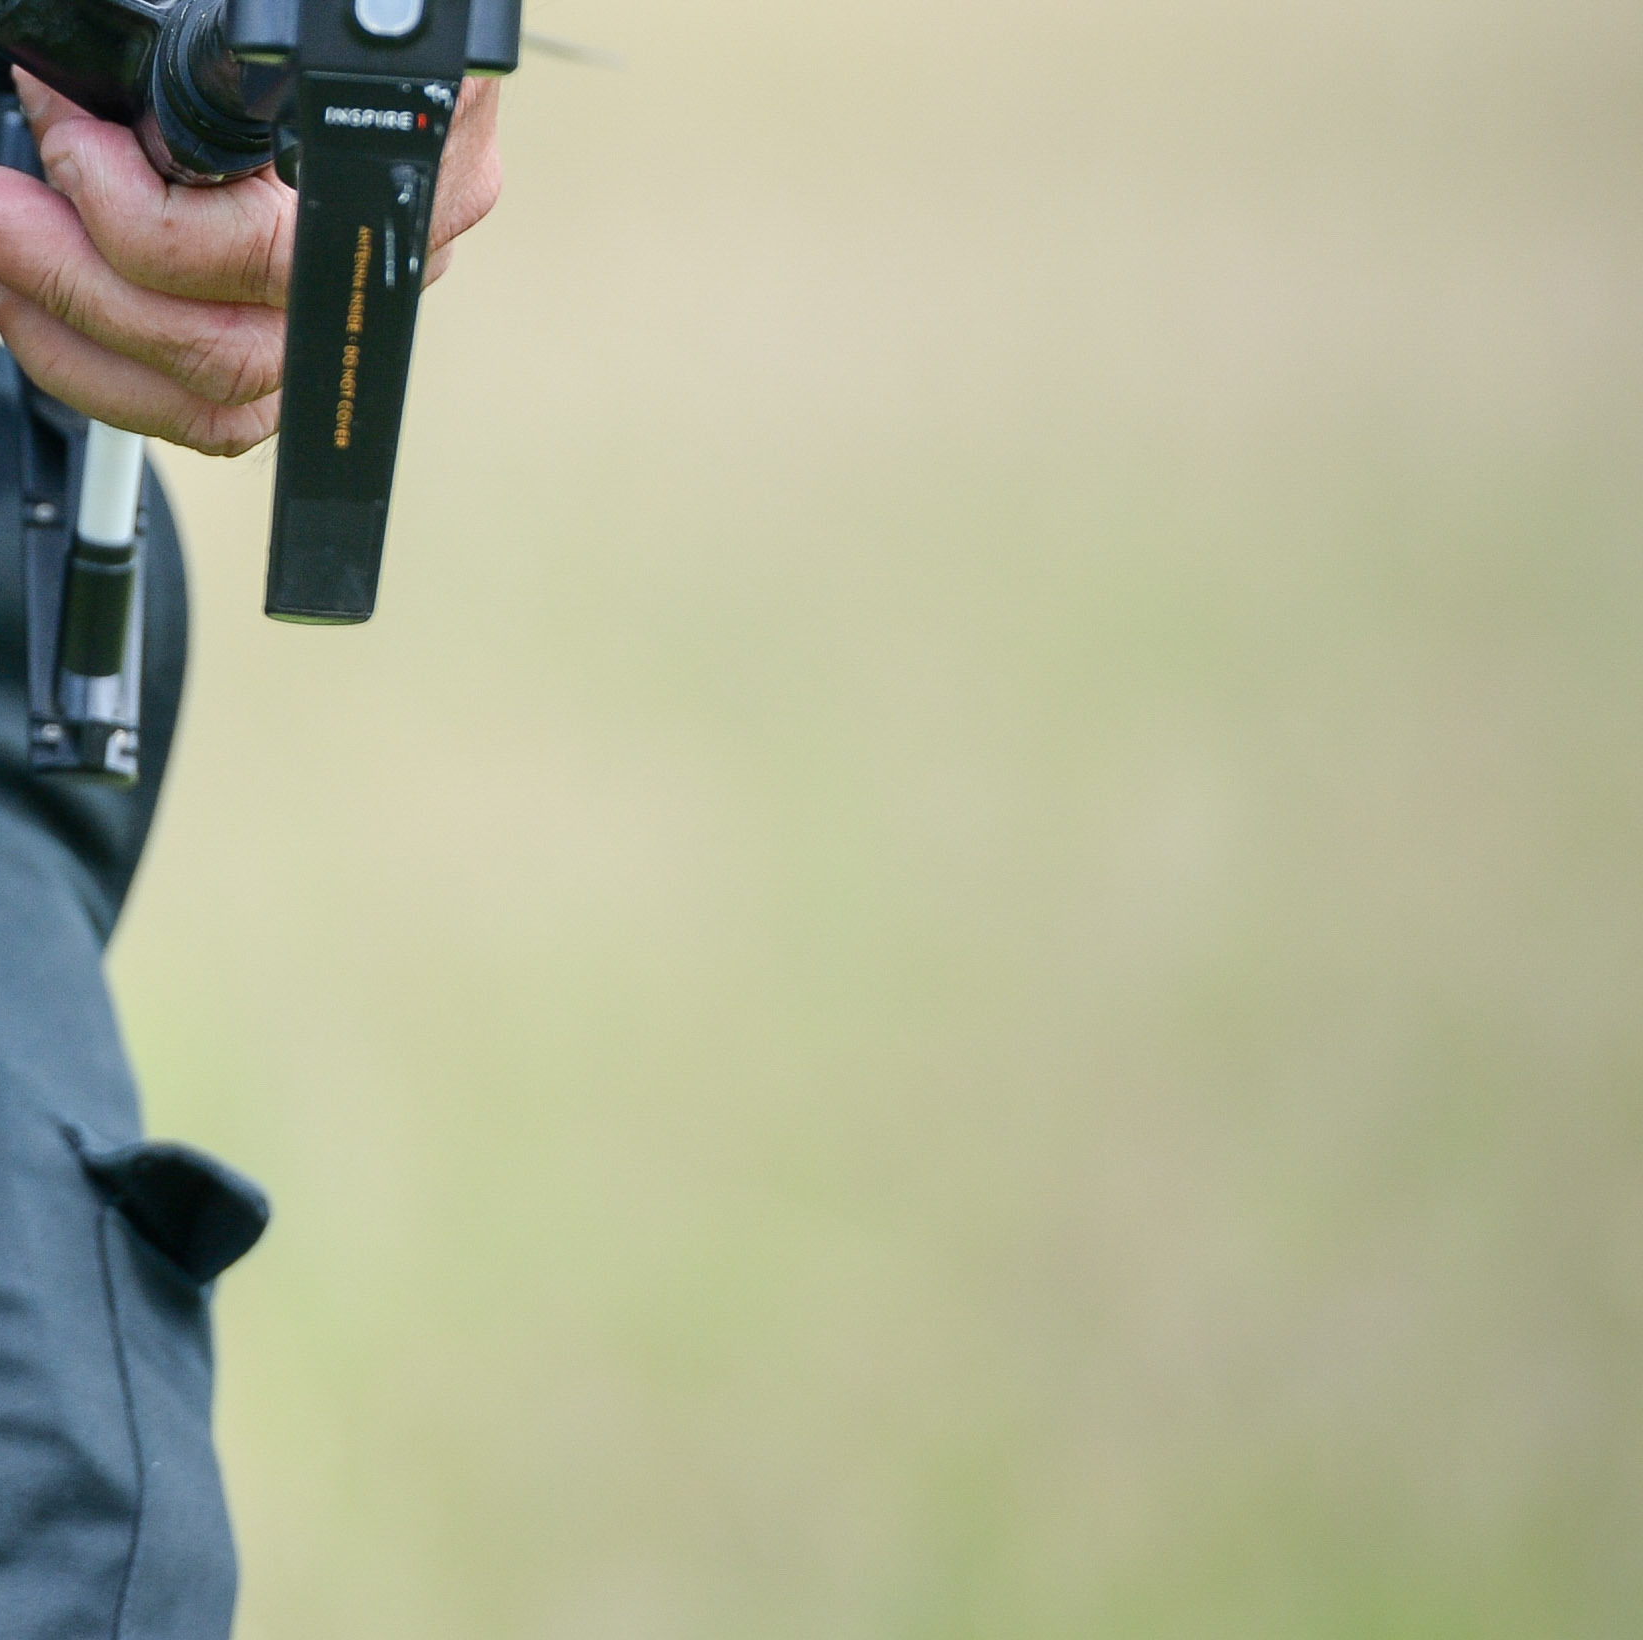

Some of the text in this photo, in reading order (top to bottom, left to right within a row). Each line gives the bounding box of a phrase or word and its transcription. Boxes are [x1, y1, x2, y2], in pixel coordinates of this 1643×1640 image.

[324, 105, 414, 131] INSPIRE
[354, 225, 372, 289] ANTENNA
[346, 290, 364, 334] INSIDE
[342, 345, 359, 368] DO
[339, 368, 357, 399] NOT
[334, 399, 353, 448] COVER
